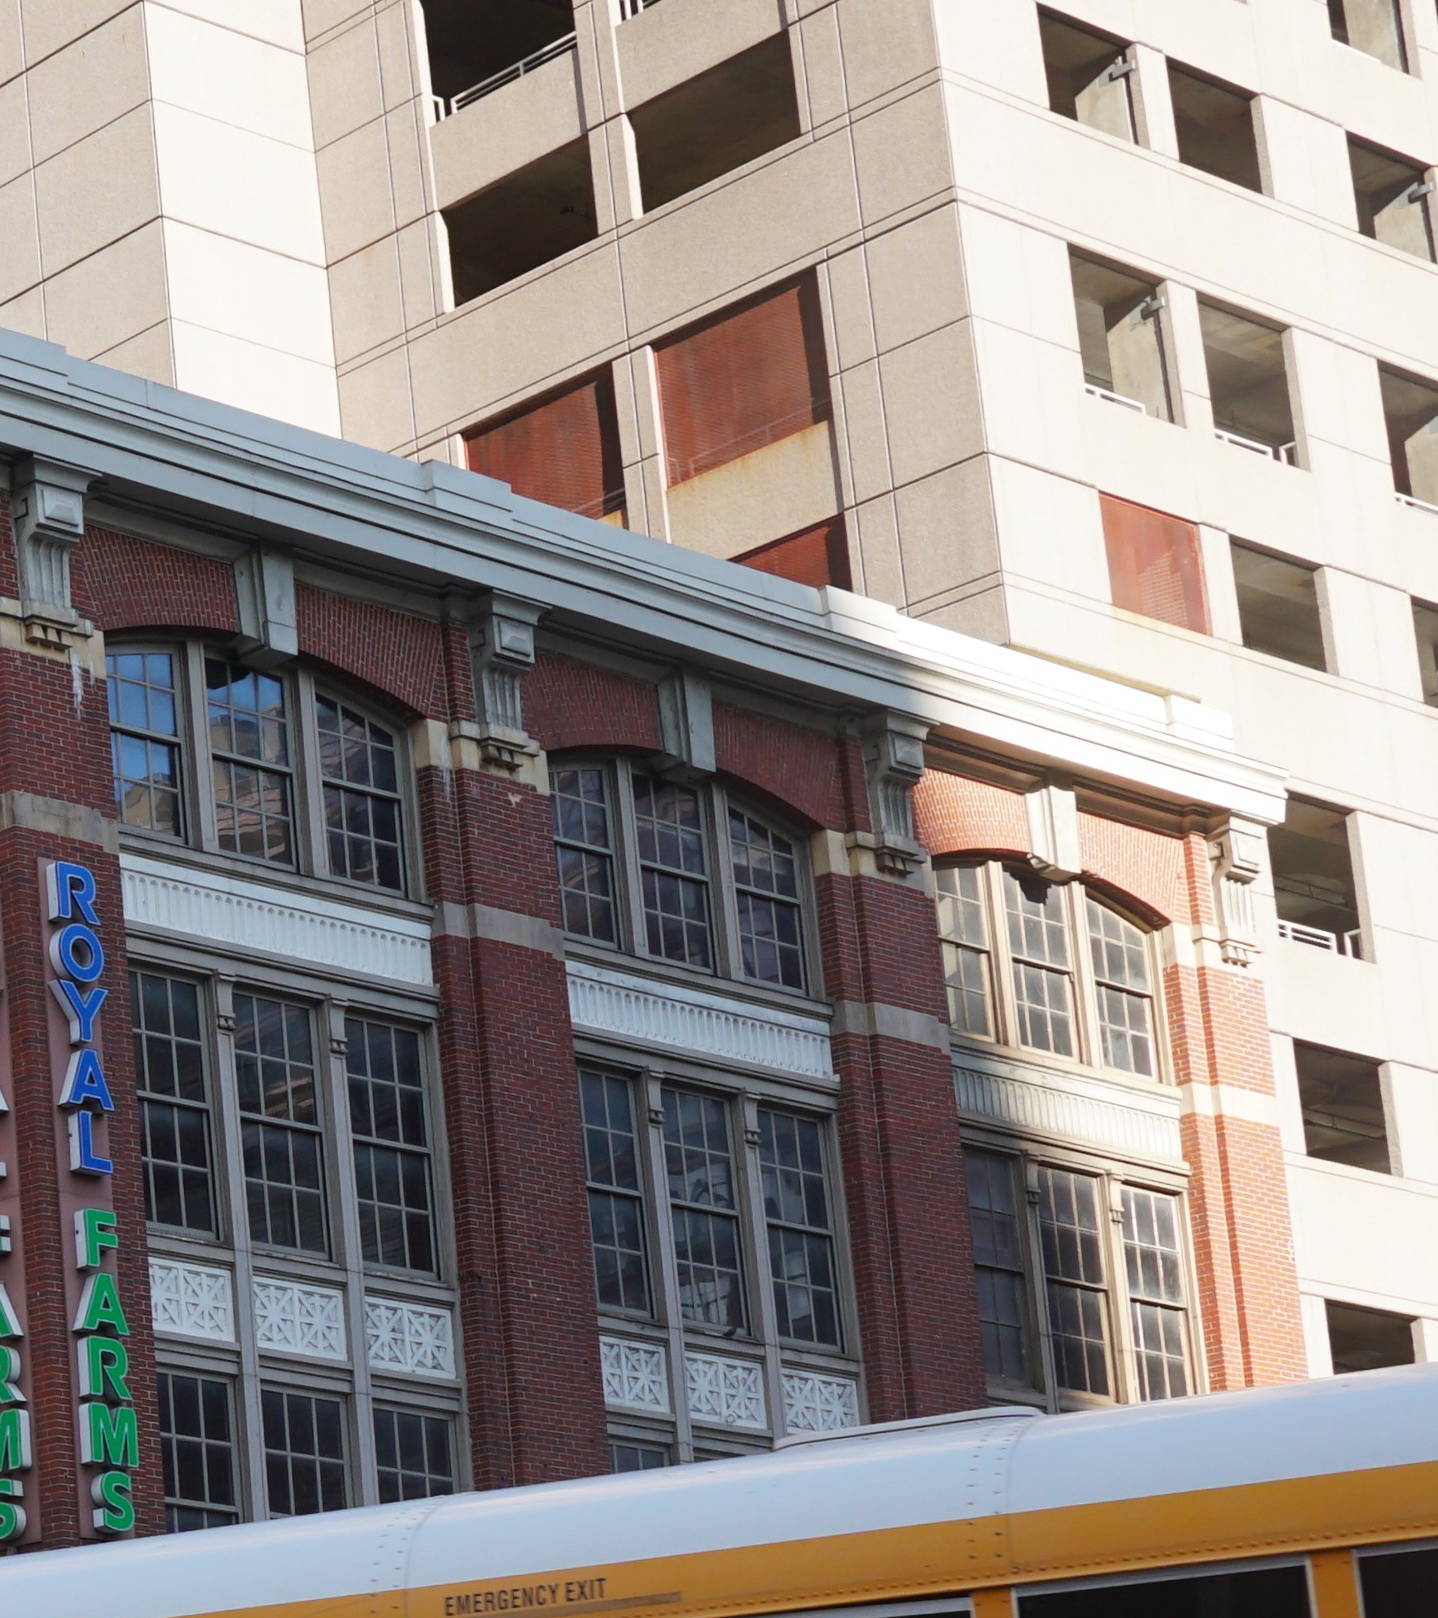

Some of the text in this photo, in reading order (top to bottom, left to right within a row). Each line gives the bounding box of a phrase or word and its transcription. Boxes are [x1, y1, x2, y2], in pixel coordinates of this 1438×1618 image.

[48, 860, 140, 1533] ROYAL FARMS
[444, 1578, 606, 1617] EMERGENCY EXIT
